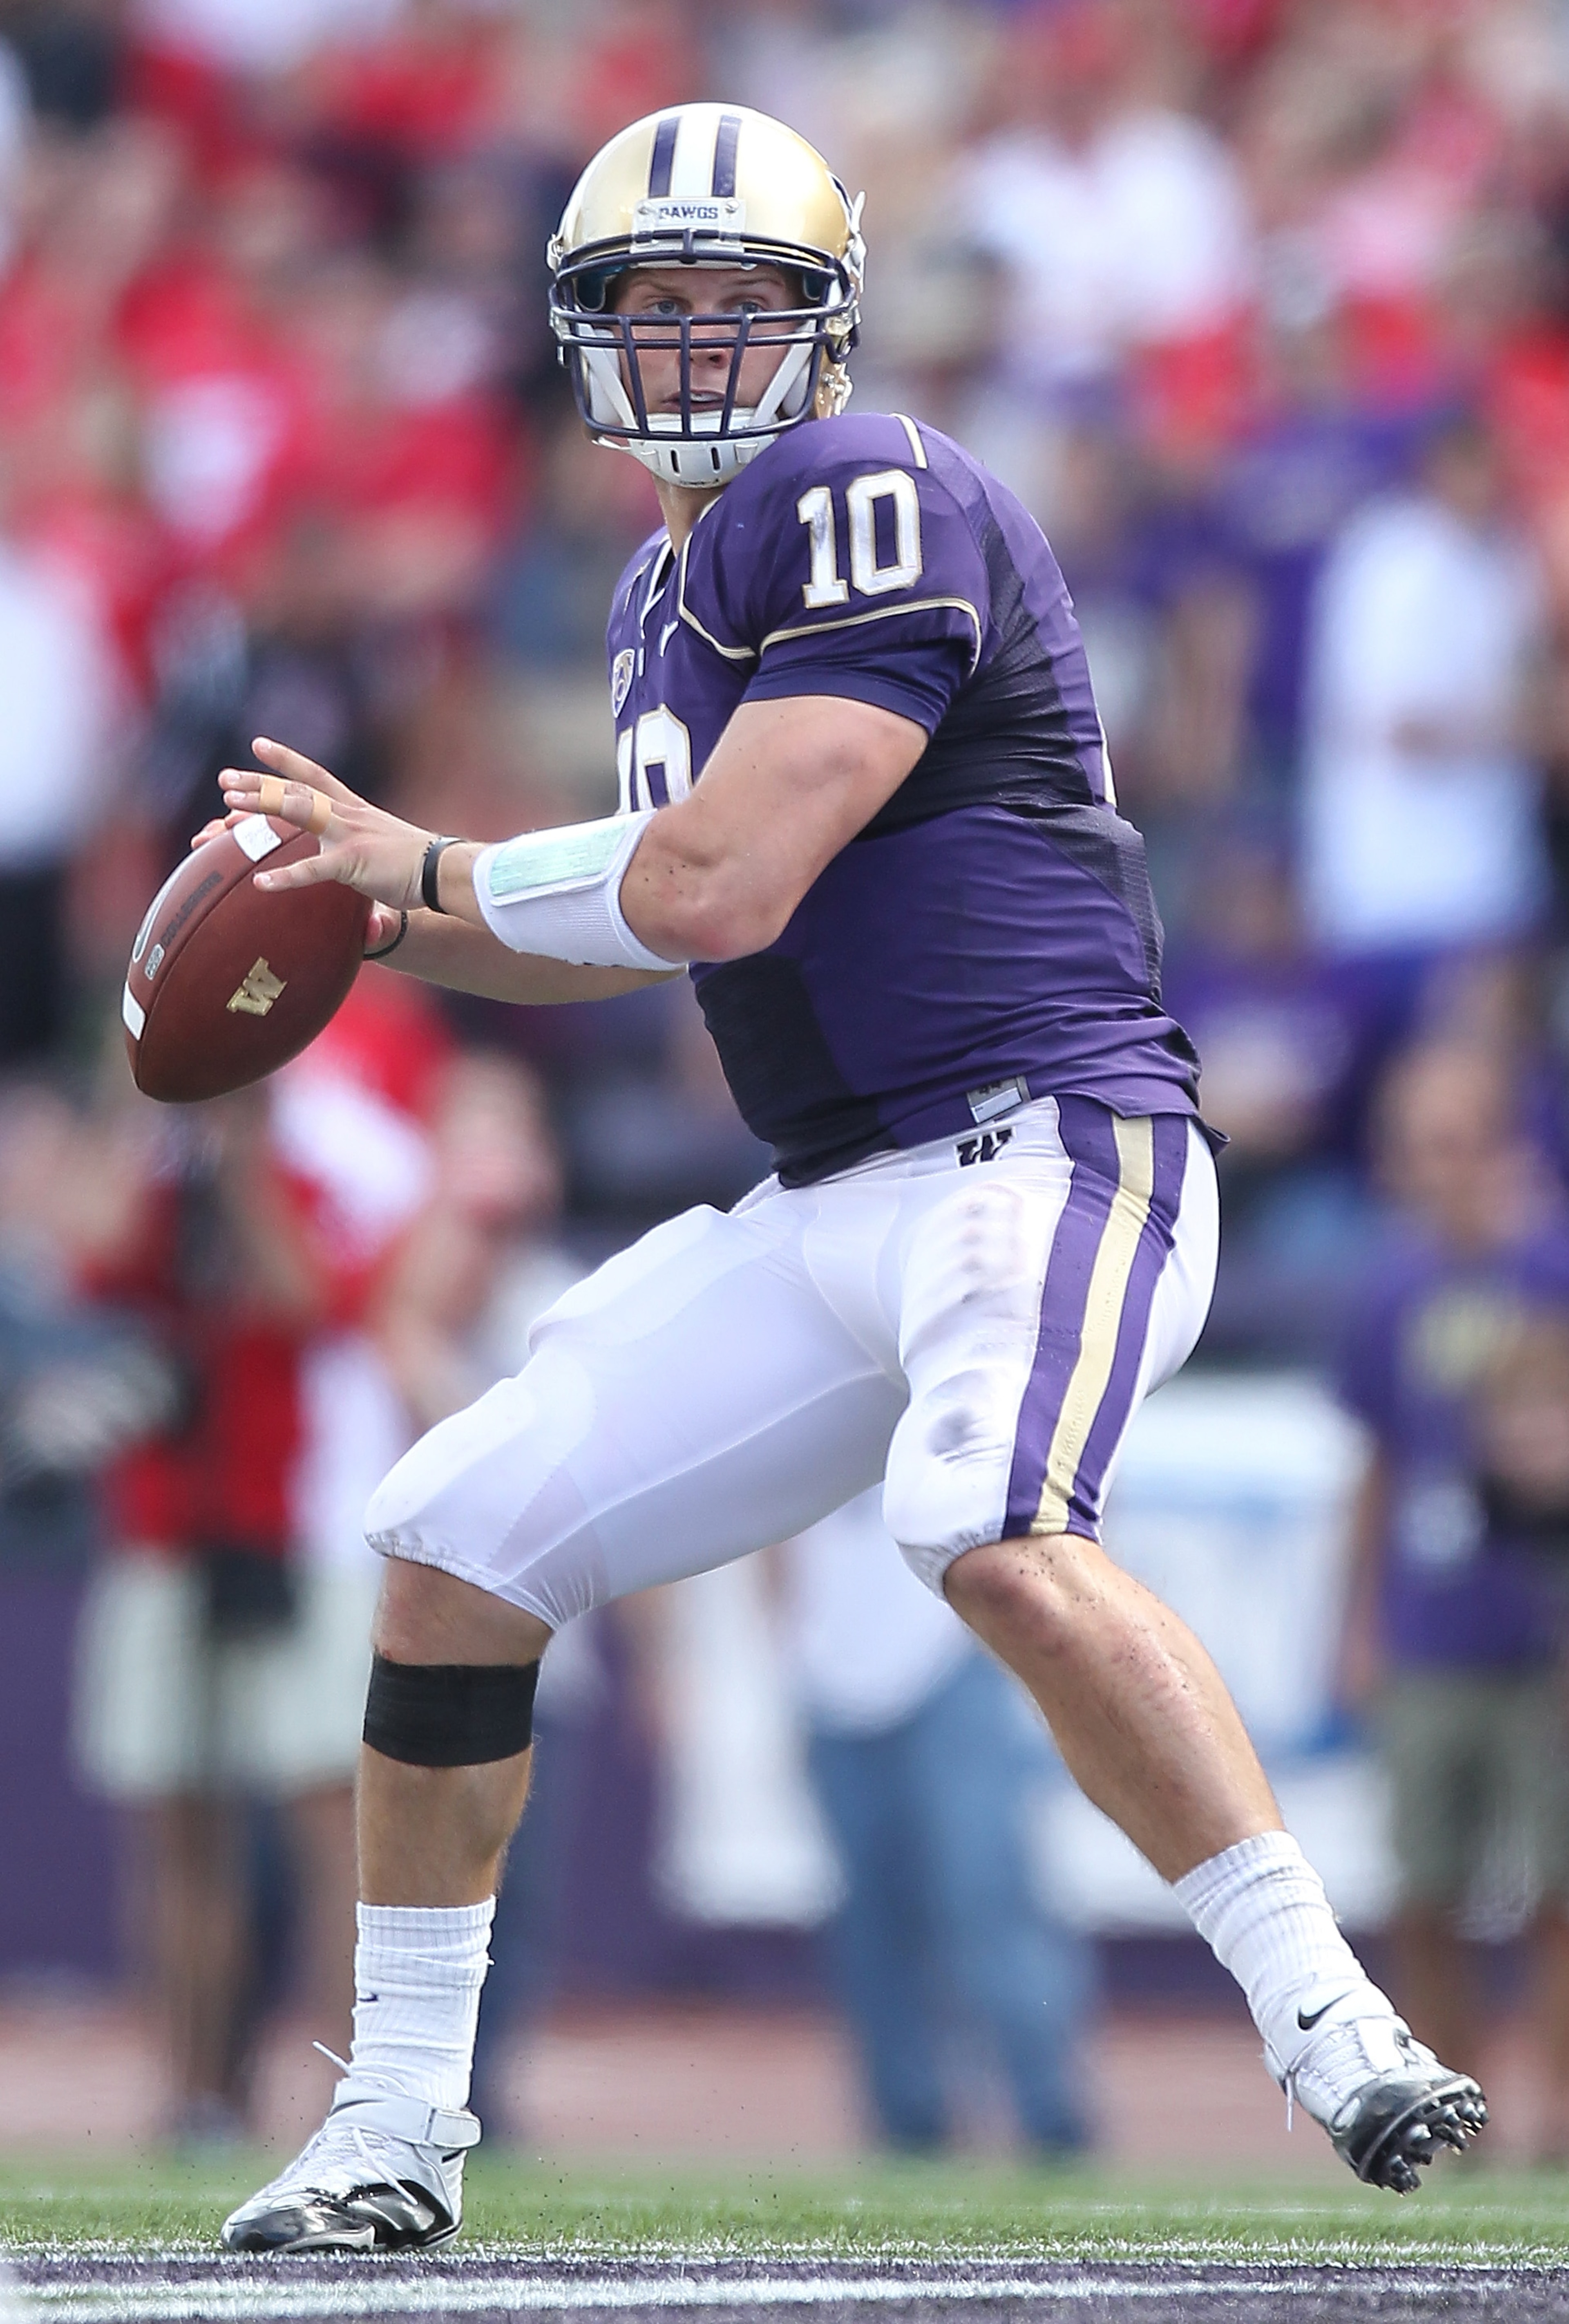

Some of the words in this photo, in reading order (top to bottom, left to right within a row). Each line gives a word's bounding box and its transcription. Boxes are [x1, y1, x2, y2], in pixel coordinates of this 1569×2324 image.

[658, 206, 718, 219] DAWGS
[797, 469, 923, 609] 10
[226, 956, 288, 1016] W
